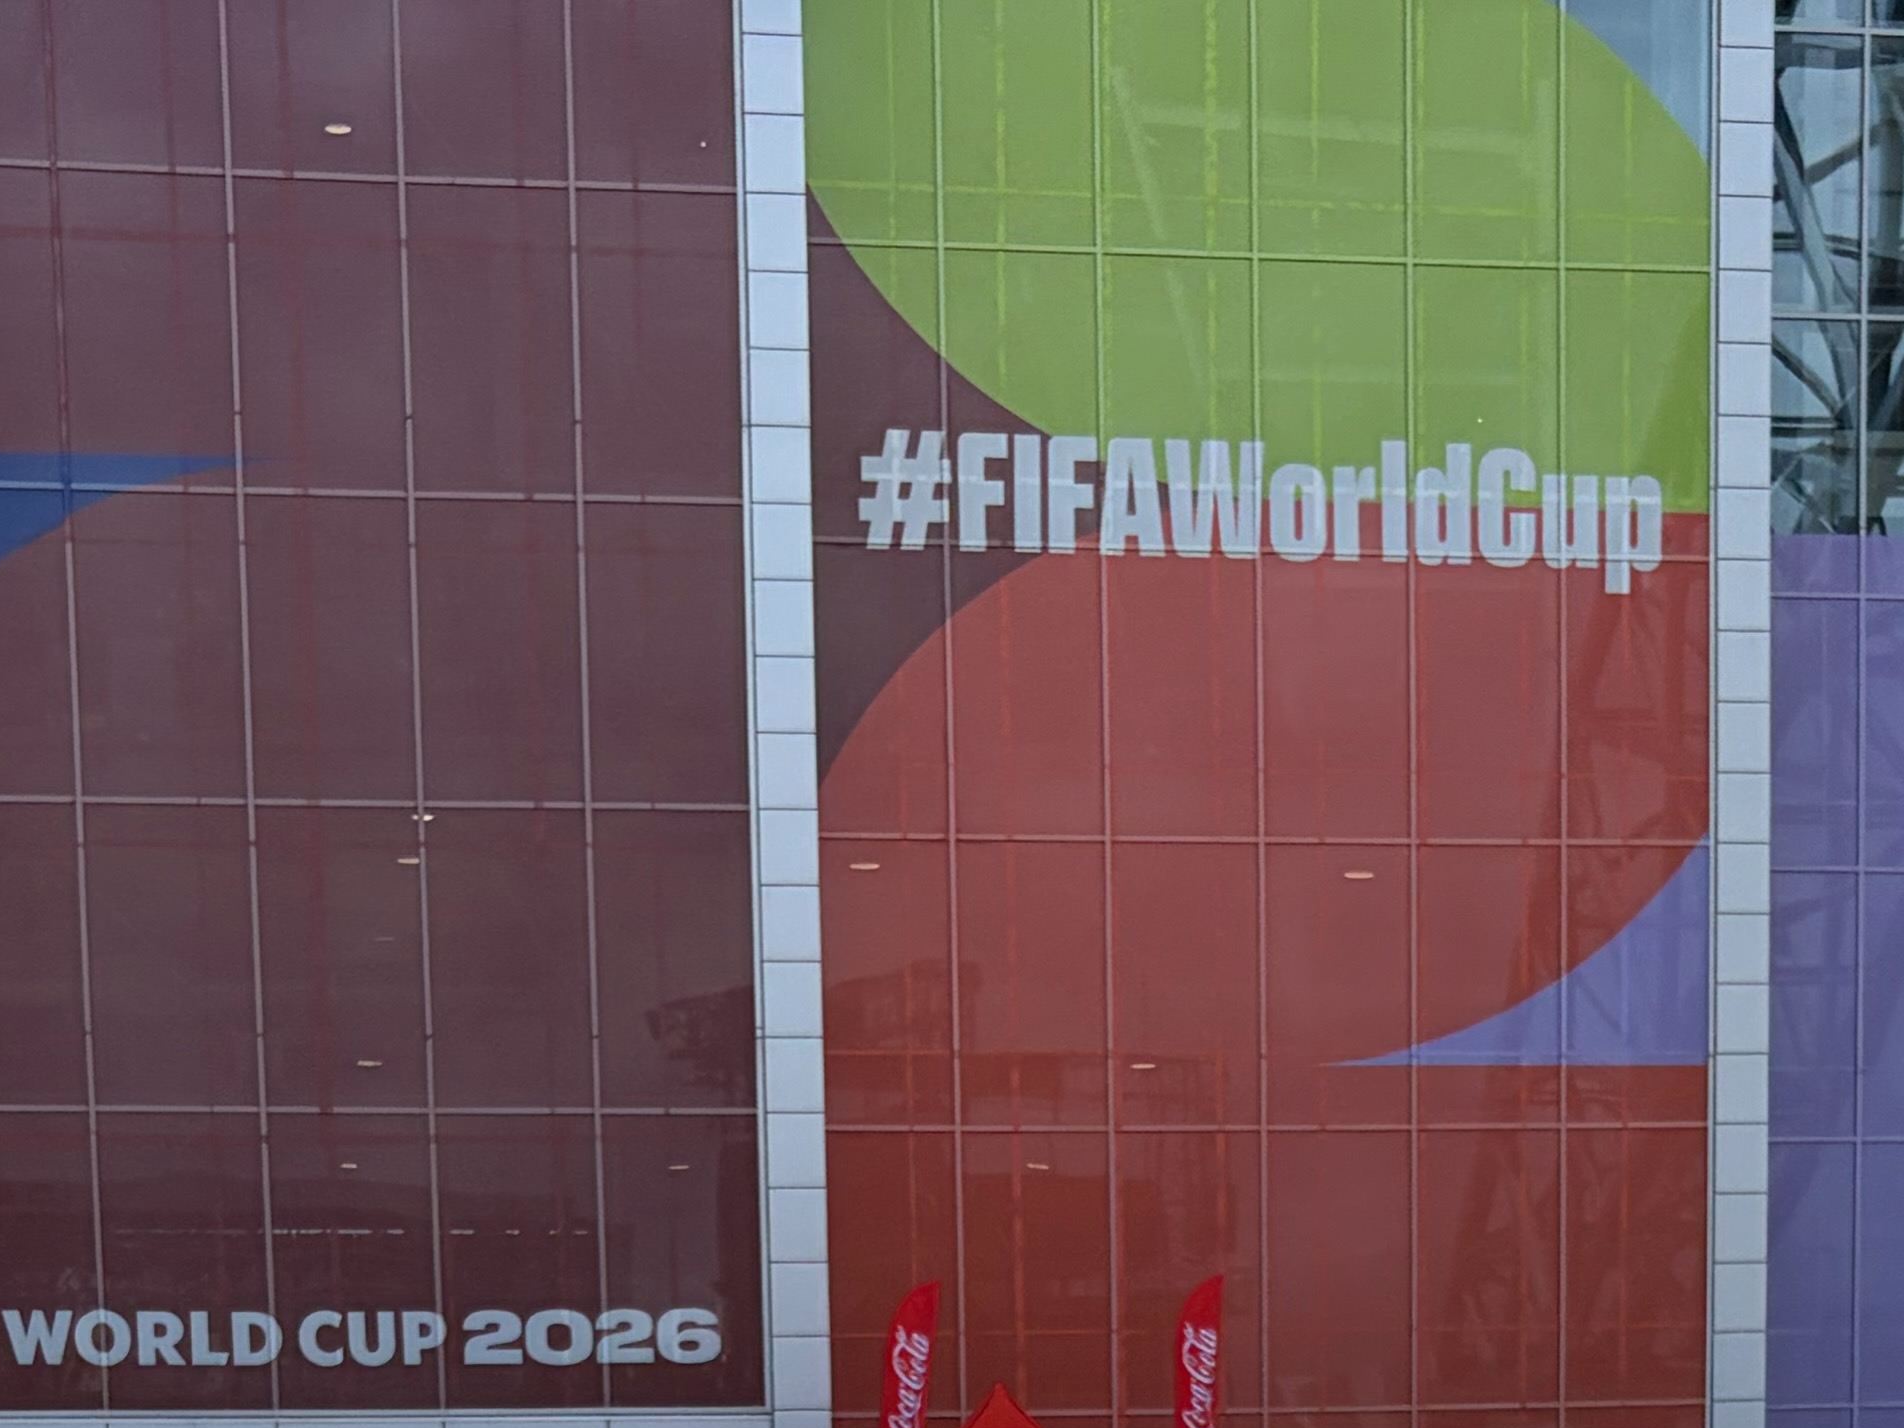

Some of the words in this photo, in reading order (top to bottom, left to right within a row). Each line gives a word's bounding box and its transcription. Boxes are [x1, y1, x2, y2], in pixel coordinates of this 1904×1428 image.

[857, 428, 1663, 594] #FIFAWorldCup
[1, 1308, 284, 1368] WORLD
[297, 1309, 447, 1368] CUP
[462, 1307, 723, 1367] 2026
